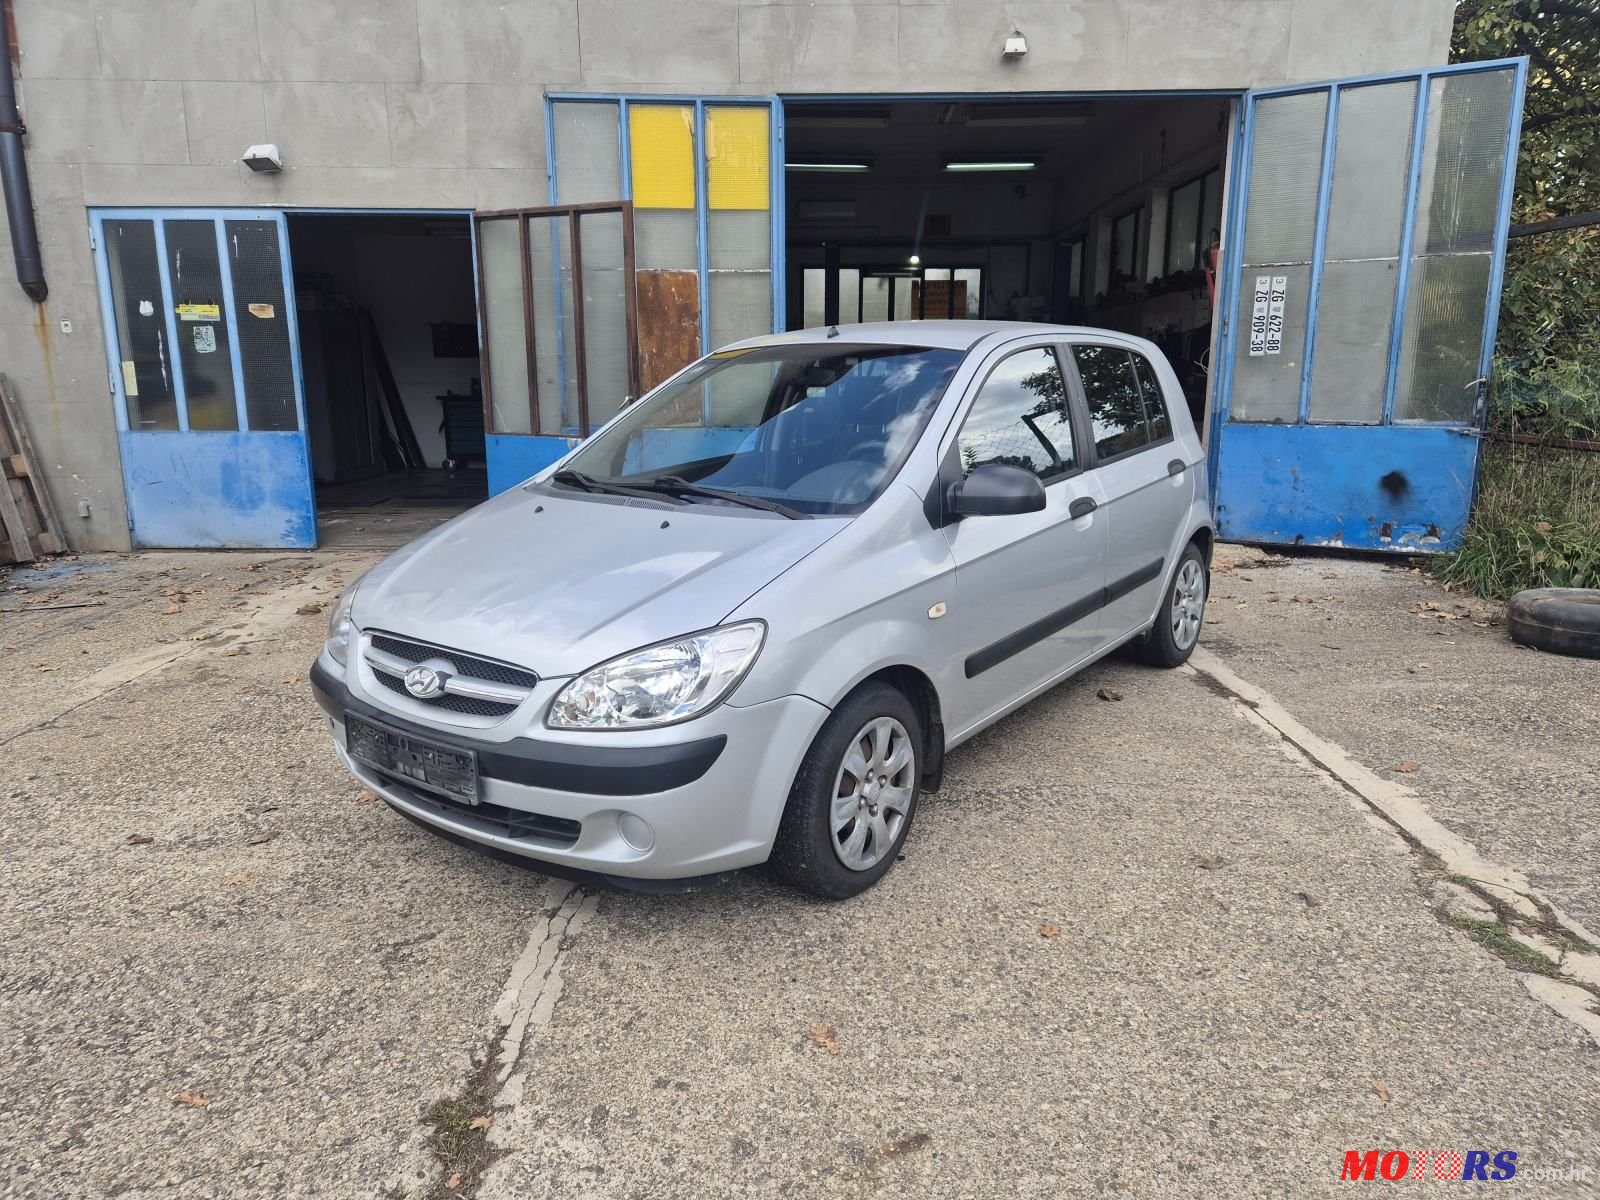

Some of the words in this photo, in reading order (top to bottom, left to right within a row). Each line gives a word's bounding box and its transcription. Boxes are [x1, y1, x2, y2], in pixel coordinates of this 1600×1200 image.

[1255, 290, 1268, 303] ZG
[1271, 289, 1285, 302] ZG
[1251, 315, 1266, 352] 909-38
[1266, 314, 1282, 351] 622-88
